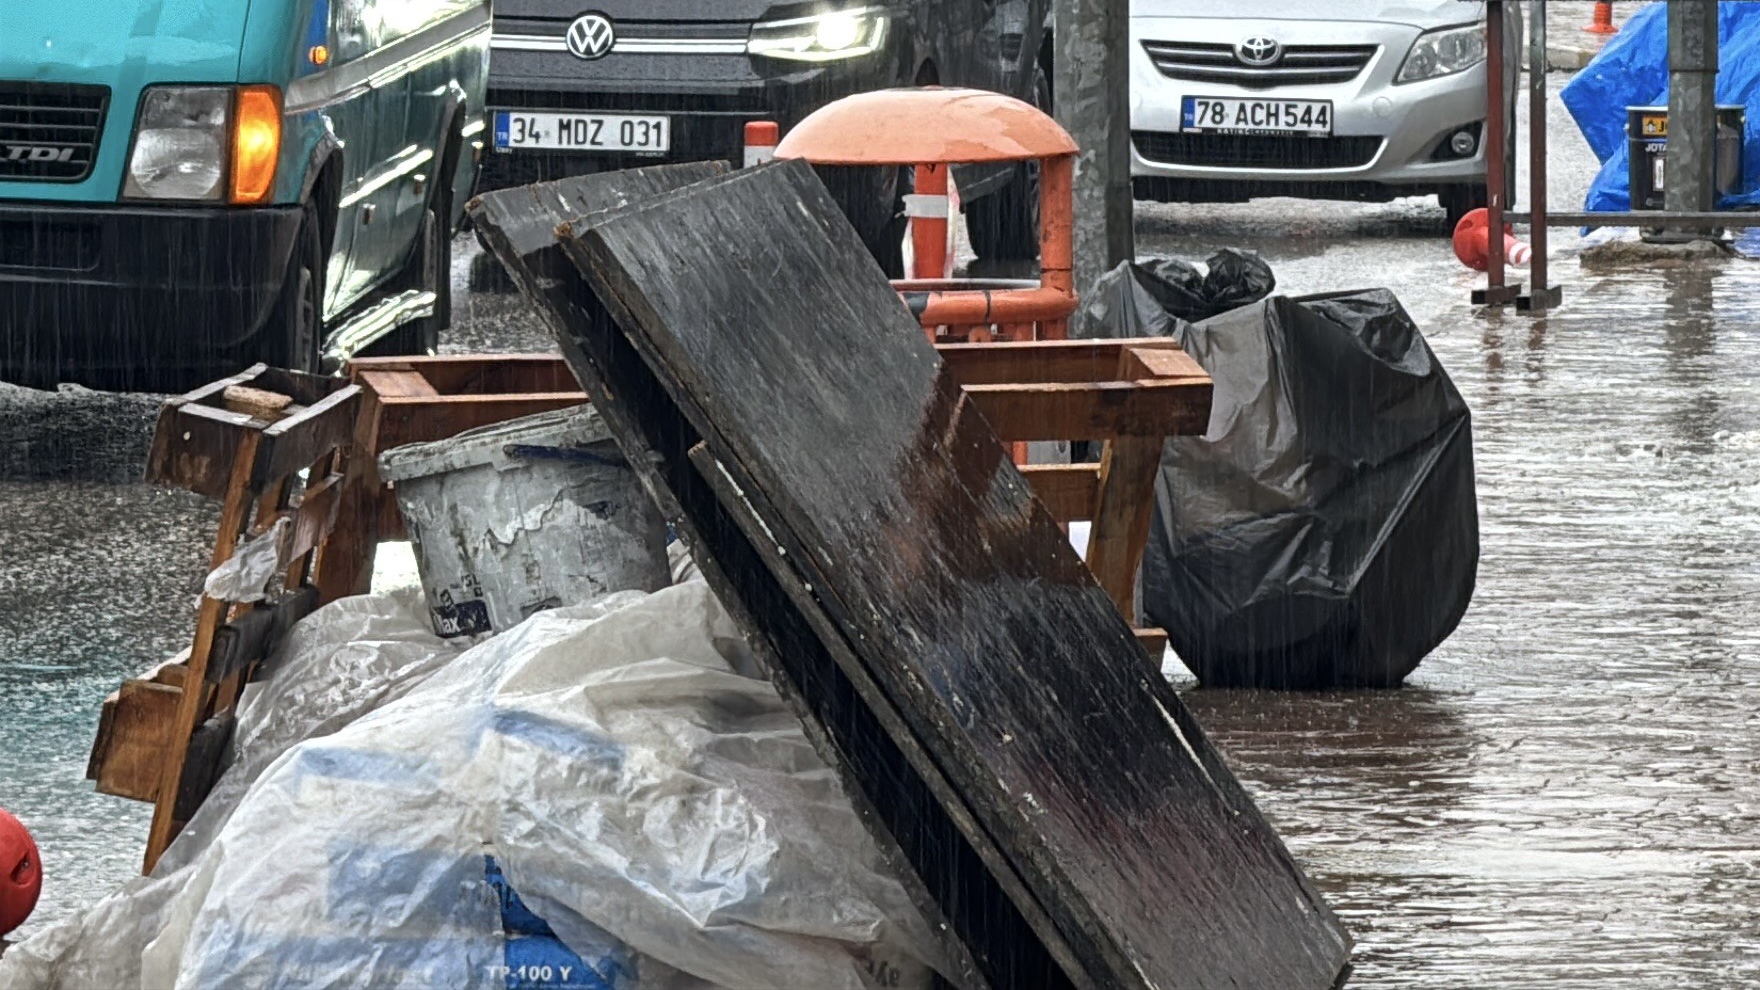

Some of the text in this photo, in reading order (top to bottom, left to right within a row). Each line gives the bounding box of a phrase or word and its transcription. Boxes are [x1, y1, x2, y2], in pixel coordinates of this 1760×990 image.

[1197, 101, 1329, 129] 78 ACH 544
[512, 117, 662, 148] 34 MDZ 031
[5, 145, 75, 162] TDI
[559, 965, 573, 982] Y
